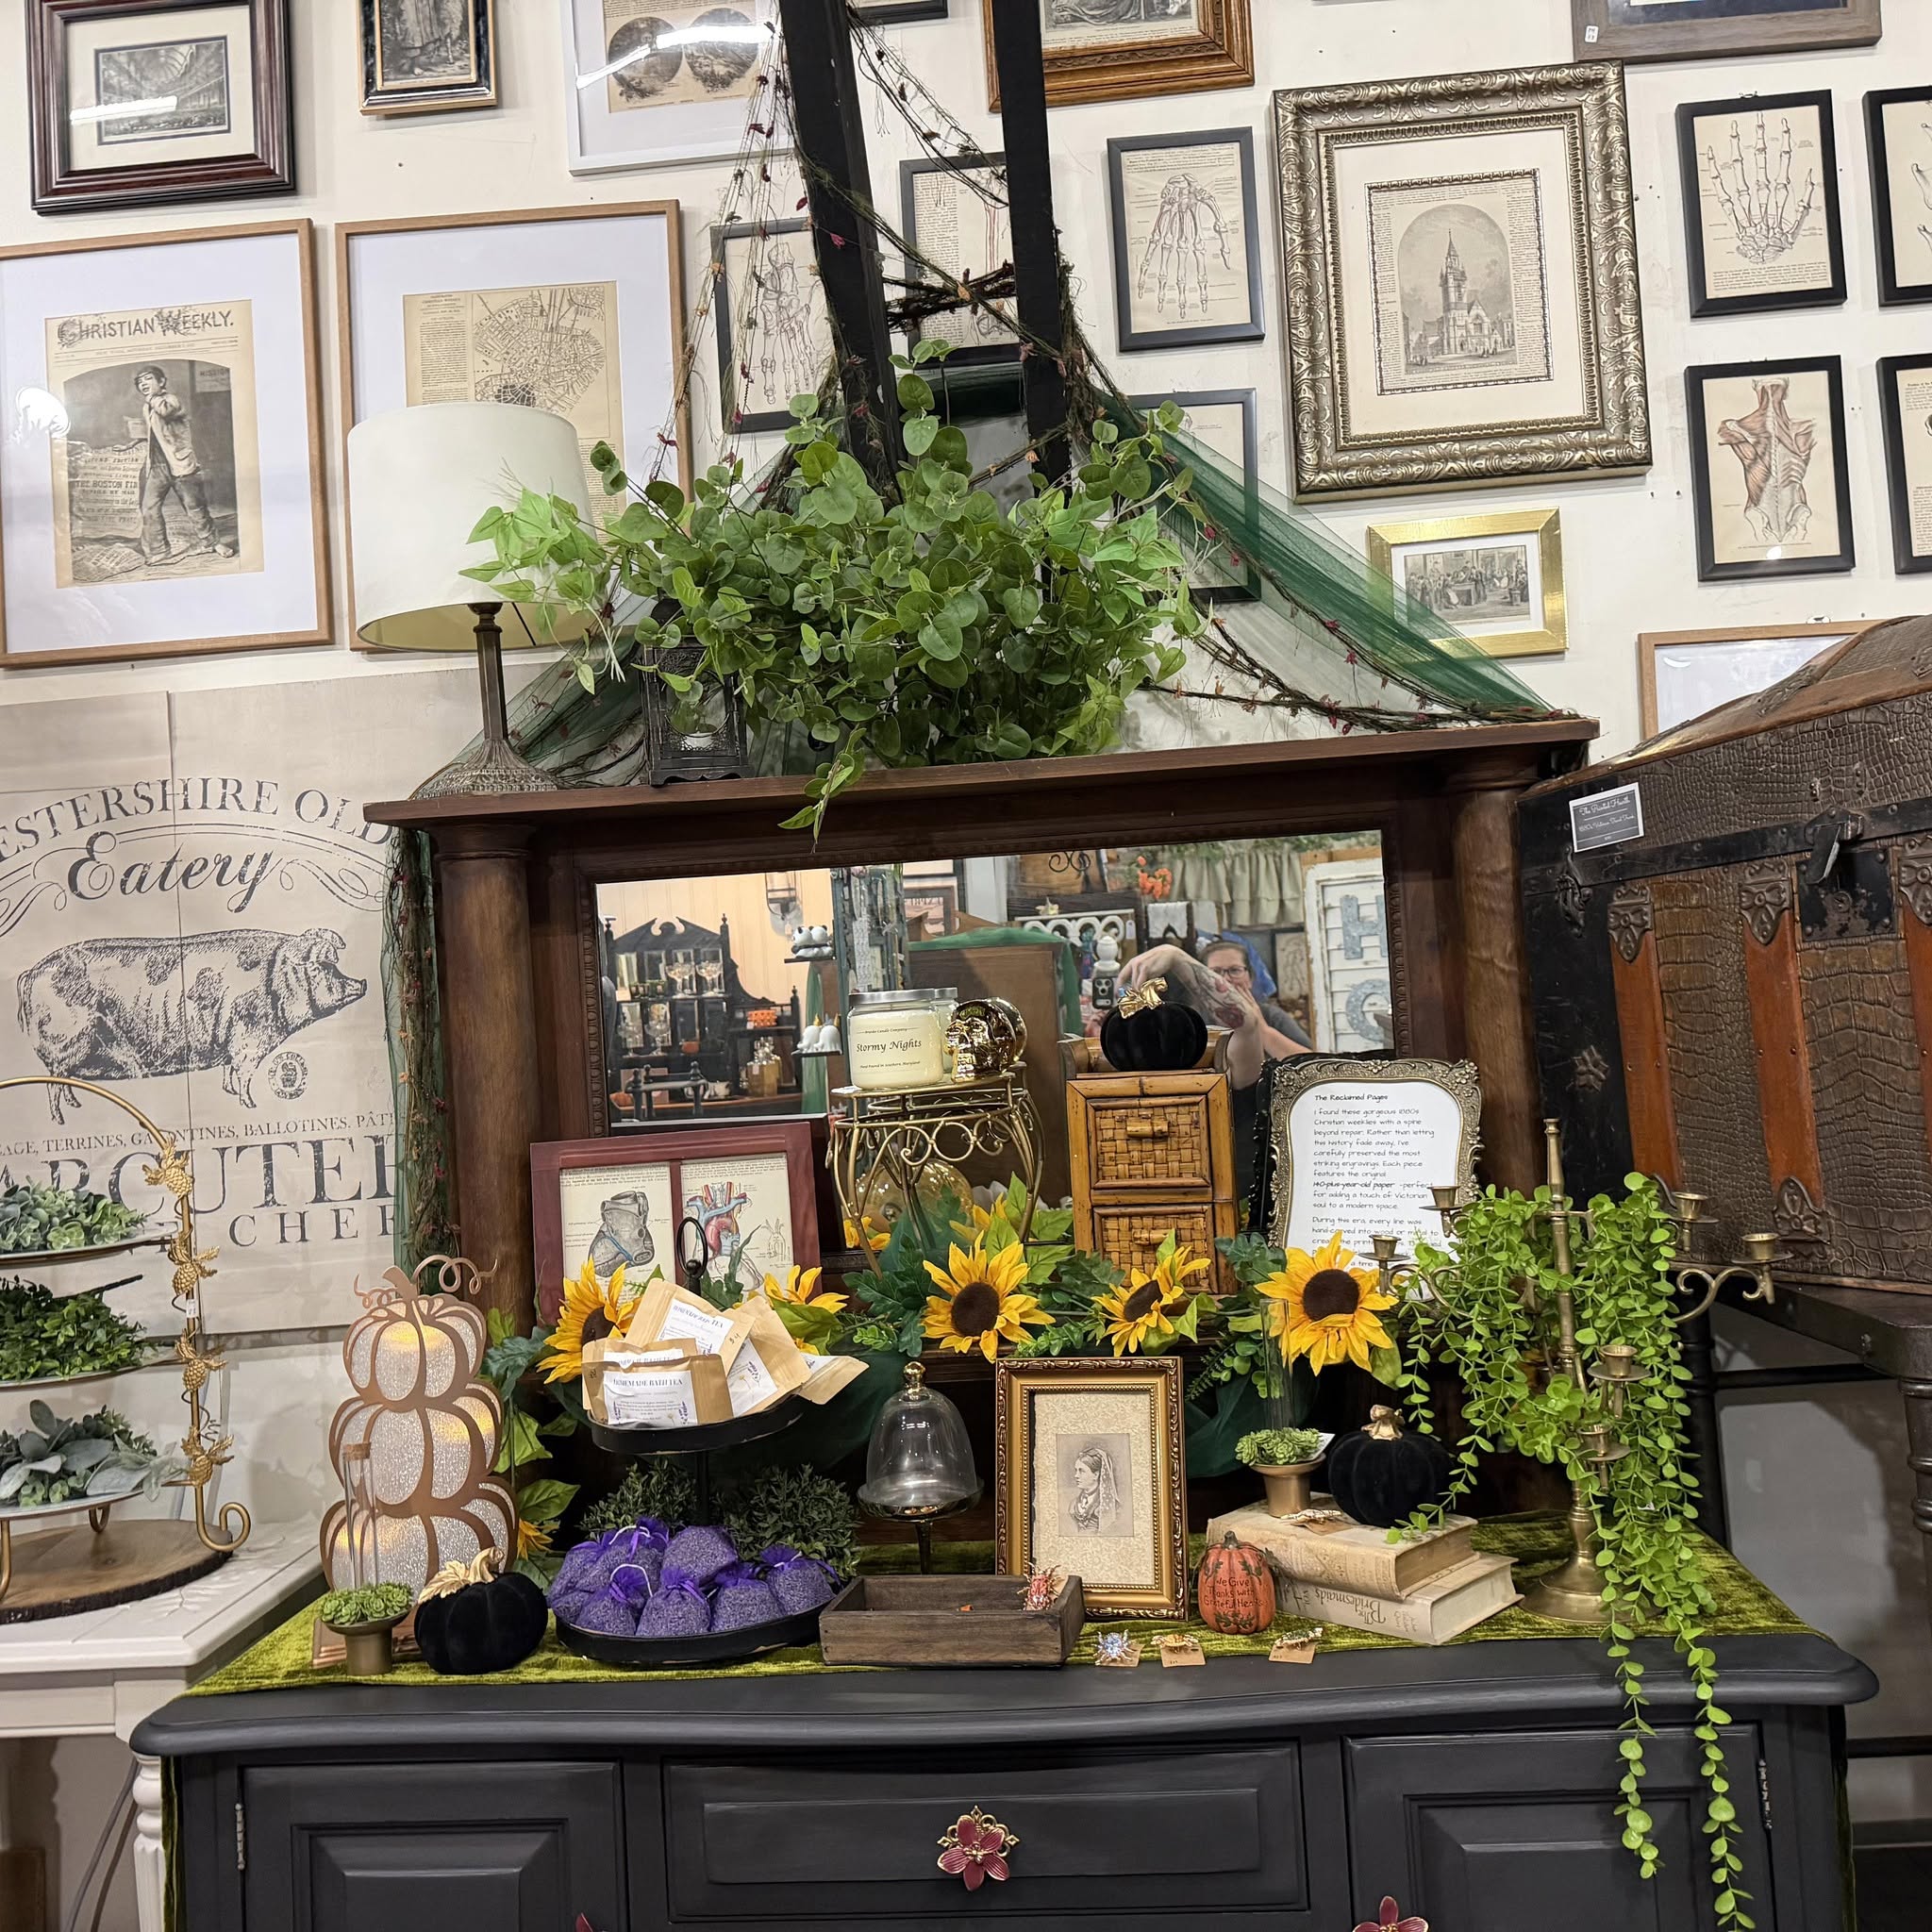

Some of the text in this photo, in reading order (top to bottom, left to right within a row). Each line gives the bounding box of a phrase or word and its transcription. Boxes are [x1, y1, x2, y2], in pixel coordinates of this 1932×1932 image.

[58, 308, 234, 348] CHRISTIAN WEEKLY.
[294, 790, 392, 845] OLD
[67, 831, 280, 912] Eatery
[857, 1039, 922, 1053] Stormy Nights
[1367, 1094, 1388, 1103] Pages
[1413, 1129, 1435, 1138] letting
[42, 1133, 127, 1154] TERRINES,
[131, 1125, 239, 1146] GANTINES,
[1328, 1140, 1353, 1148] history
[1314, 1149, 1345, 1158] carefully
[1313, 1160, 1340, 1169] striking
[1361, 1172, 1387, 1180] original
[1328, 1191, 1350, 1201] adding
[1312, 1217, 1335, 1225] During
[1228, 1577, 1250, 1587] Give
[1208, 1586, 1234, 1598] Thanks
[1204, 1595, 1263, 1608] Grateful Hearts
[1314, 1588, 1386, 1624] Bridesmaids
[1357, 1608, 1374, 1624] The
